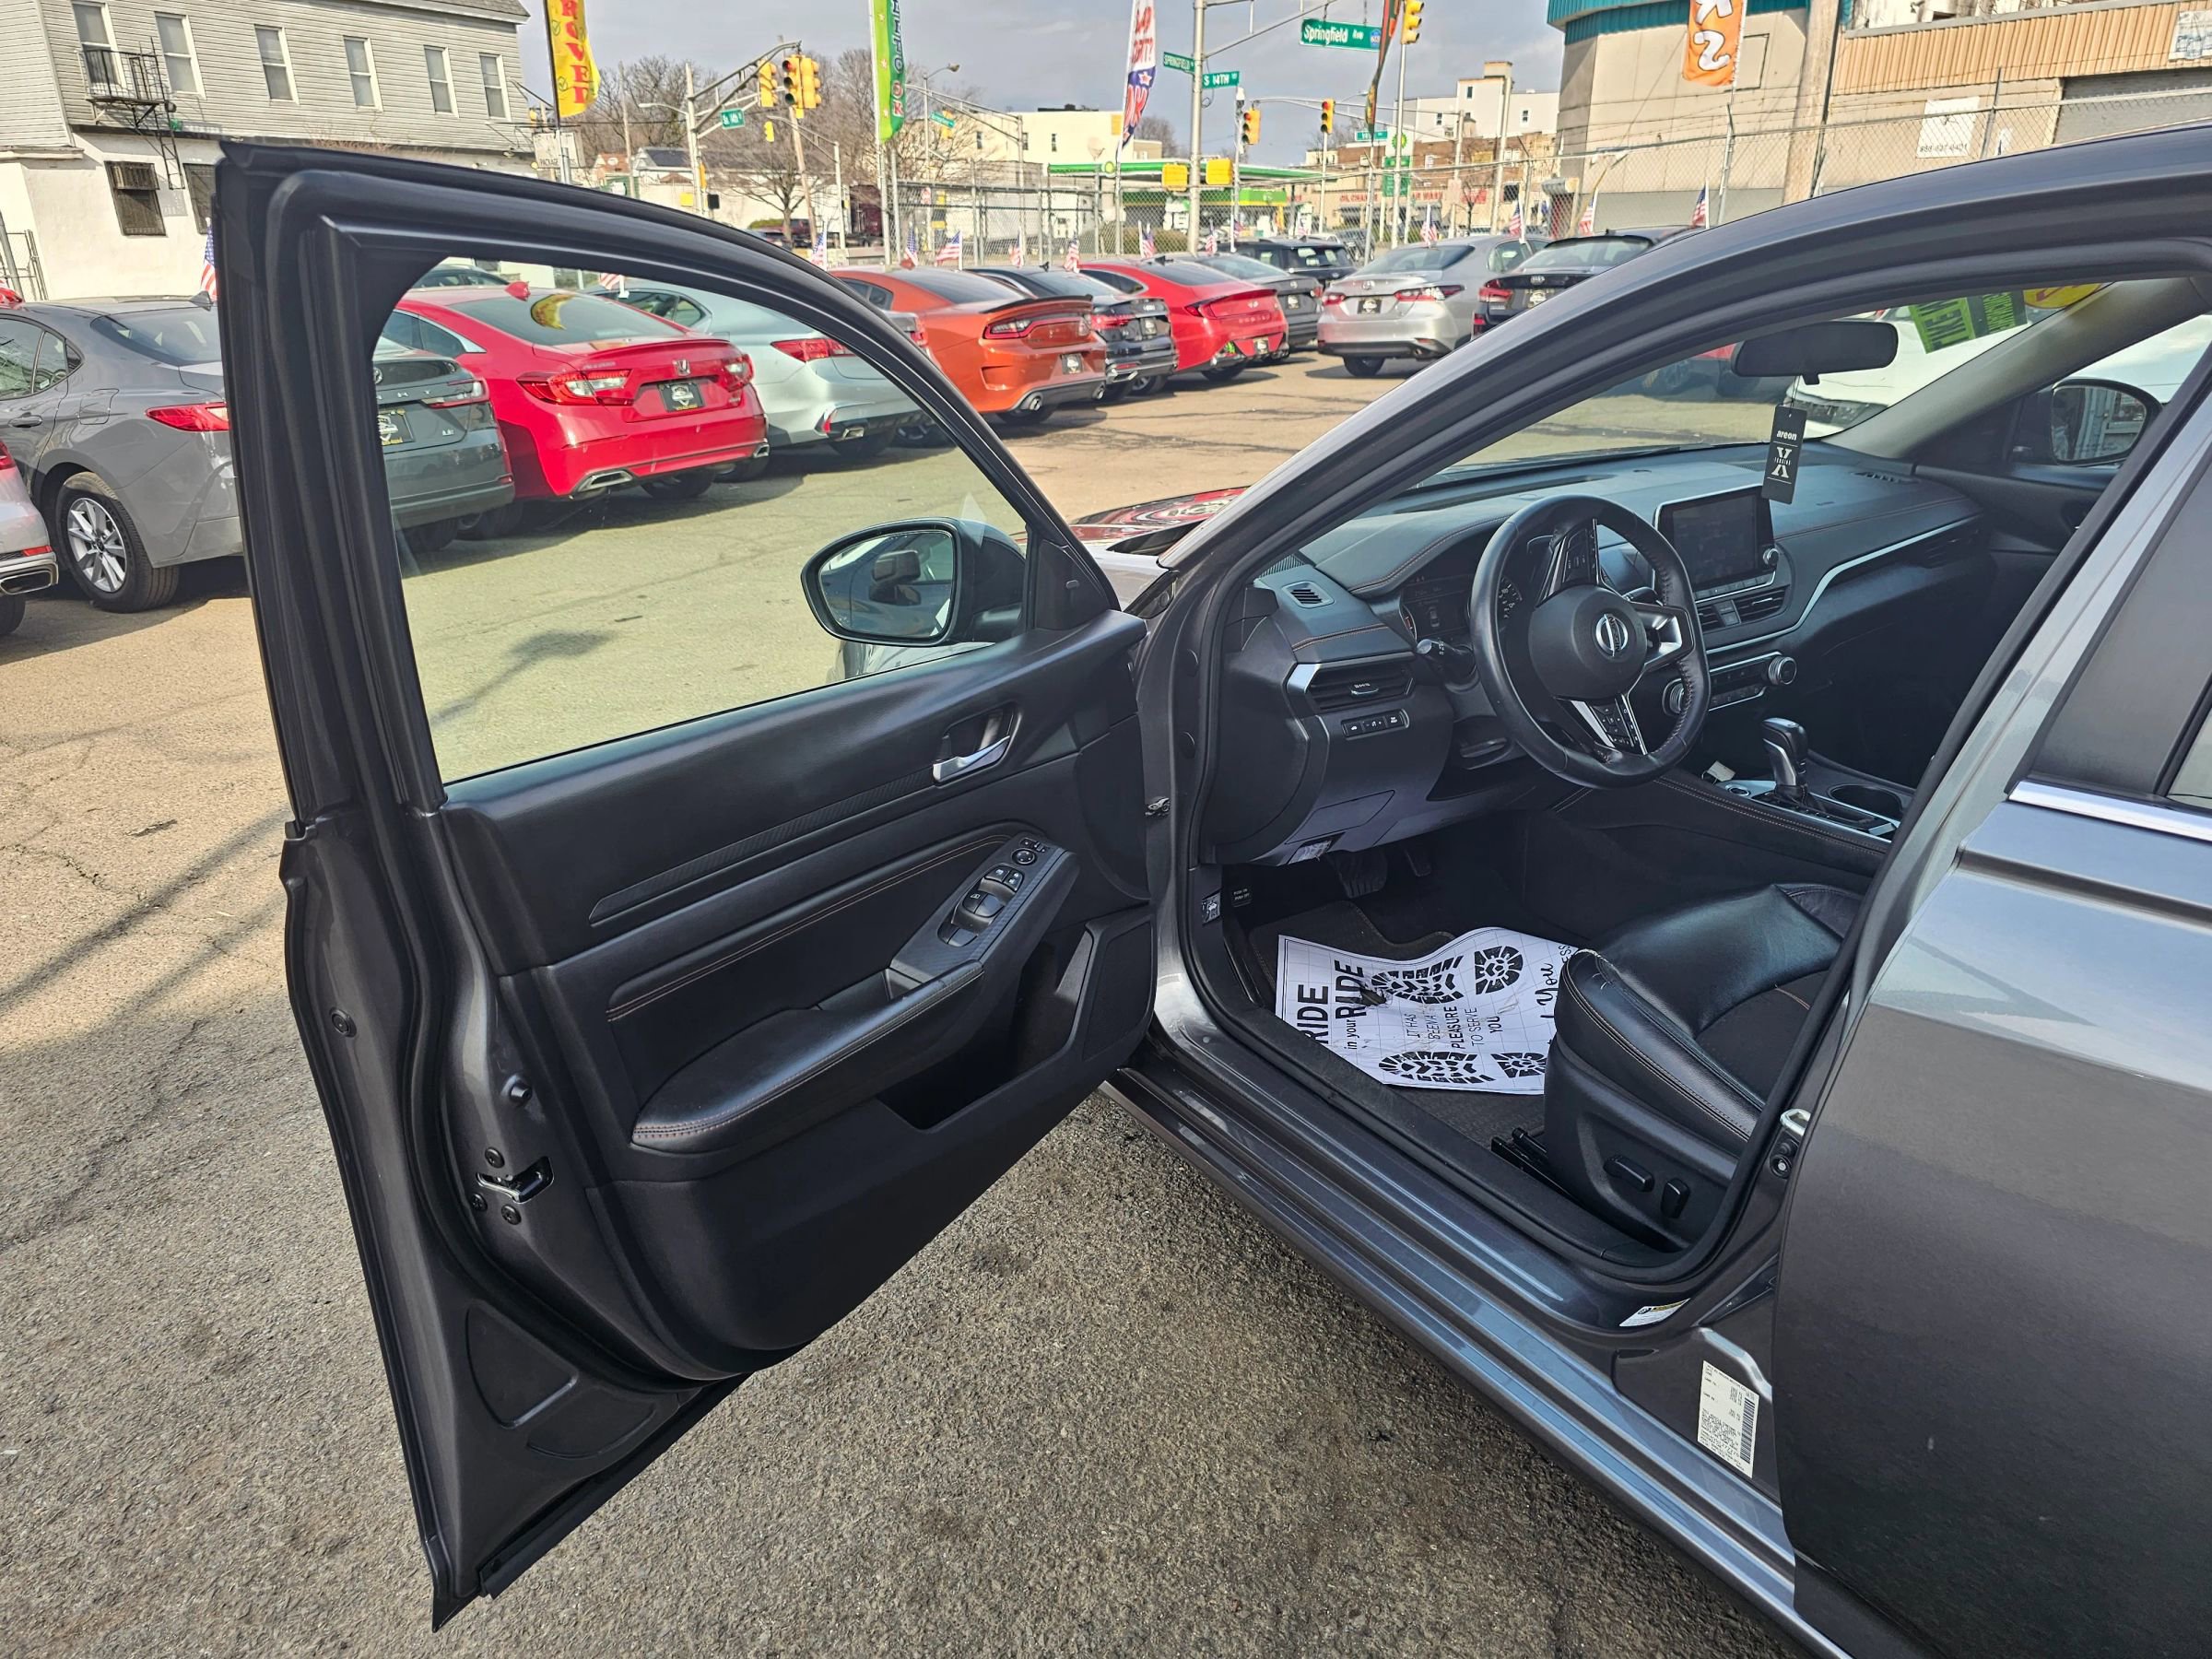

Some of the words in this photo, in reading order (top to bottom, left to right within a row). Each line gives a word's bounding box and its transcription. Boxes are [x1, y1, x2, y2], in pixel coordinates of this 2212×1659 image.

[1304, 25, 1348, 44] Springfield
[1204, 75, 1210, 86] S
[1776, 429, 1797, 441] areon
[1335, 960, 1367, 1019] RIDE
[1404, 1013, 1418, 1028] HAS
[1443, 1006, 1465, 1050] PLEASURE
[1465, 1007, 1482, 1032] SERVE
[1487, 1016, 1503, 1033] YOU
[1347, 1019, 1359, 1039] your
[1344, 1041, 1358, 1050] in
[1471, 1034, 1485, 1046] TO
